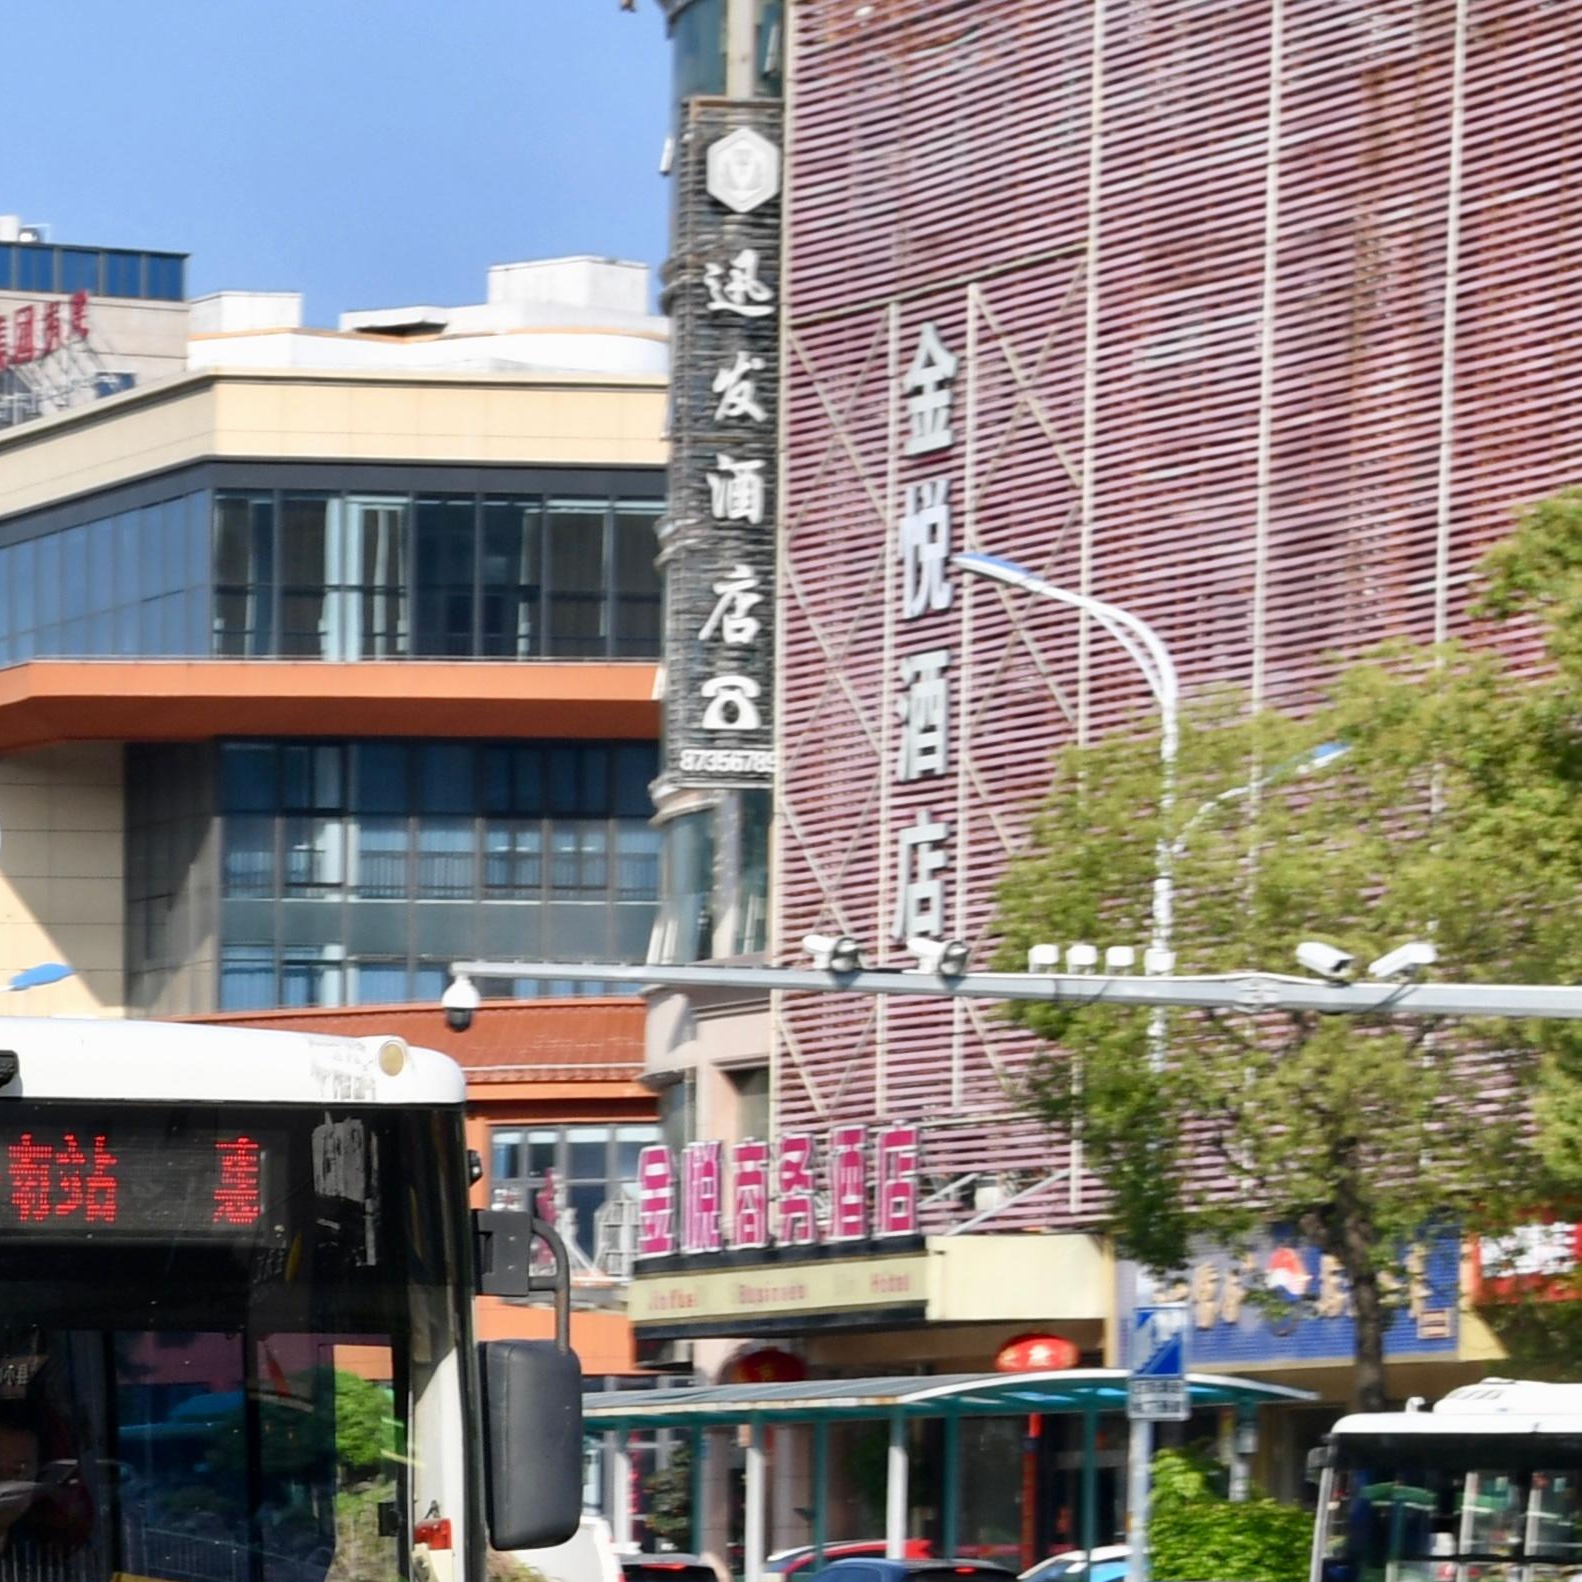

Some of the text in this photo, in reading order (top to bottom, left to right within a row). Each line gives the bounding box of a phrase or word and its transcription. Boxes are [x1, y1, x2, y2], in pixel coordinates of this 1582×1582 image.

[894, 323, 959, 943] 金悦酒店
[638, 1120, 919, 1257] 金悦商务酒店
